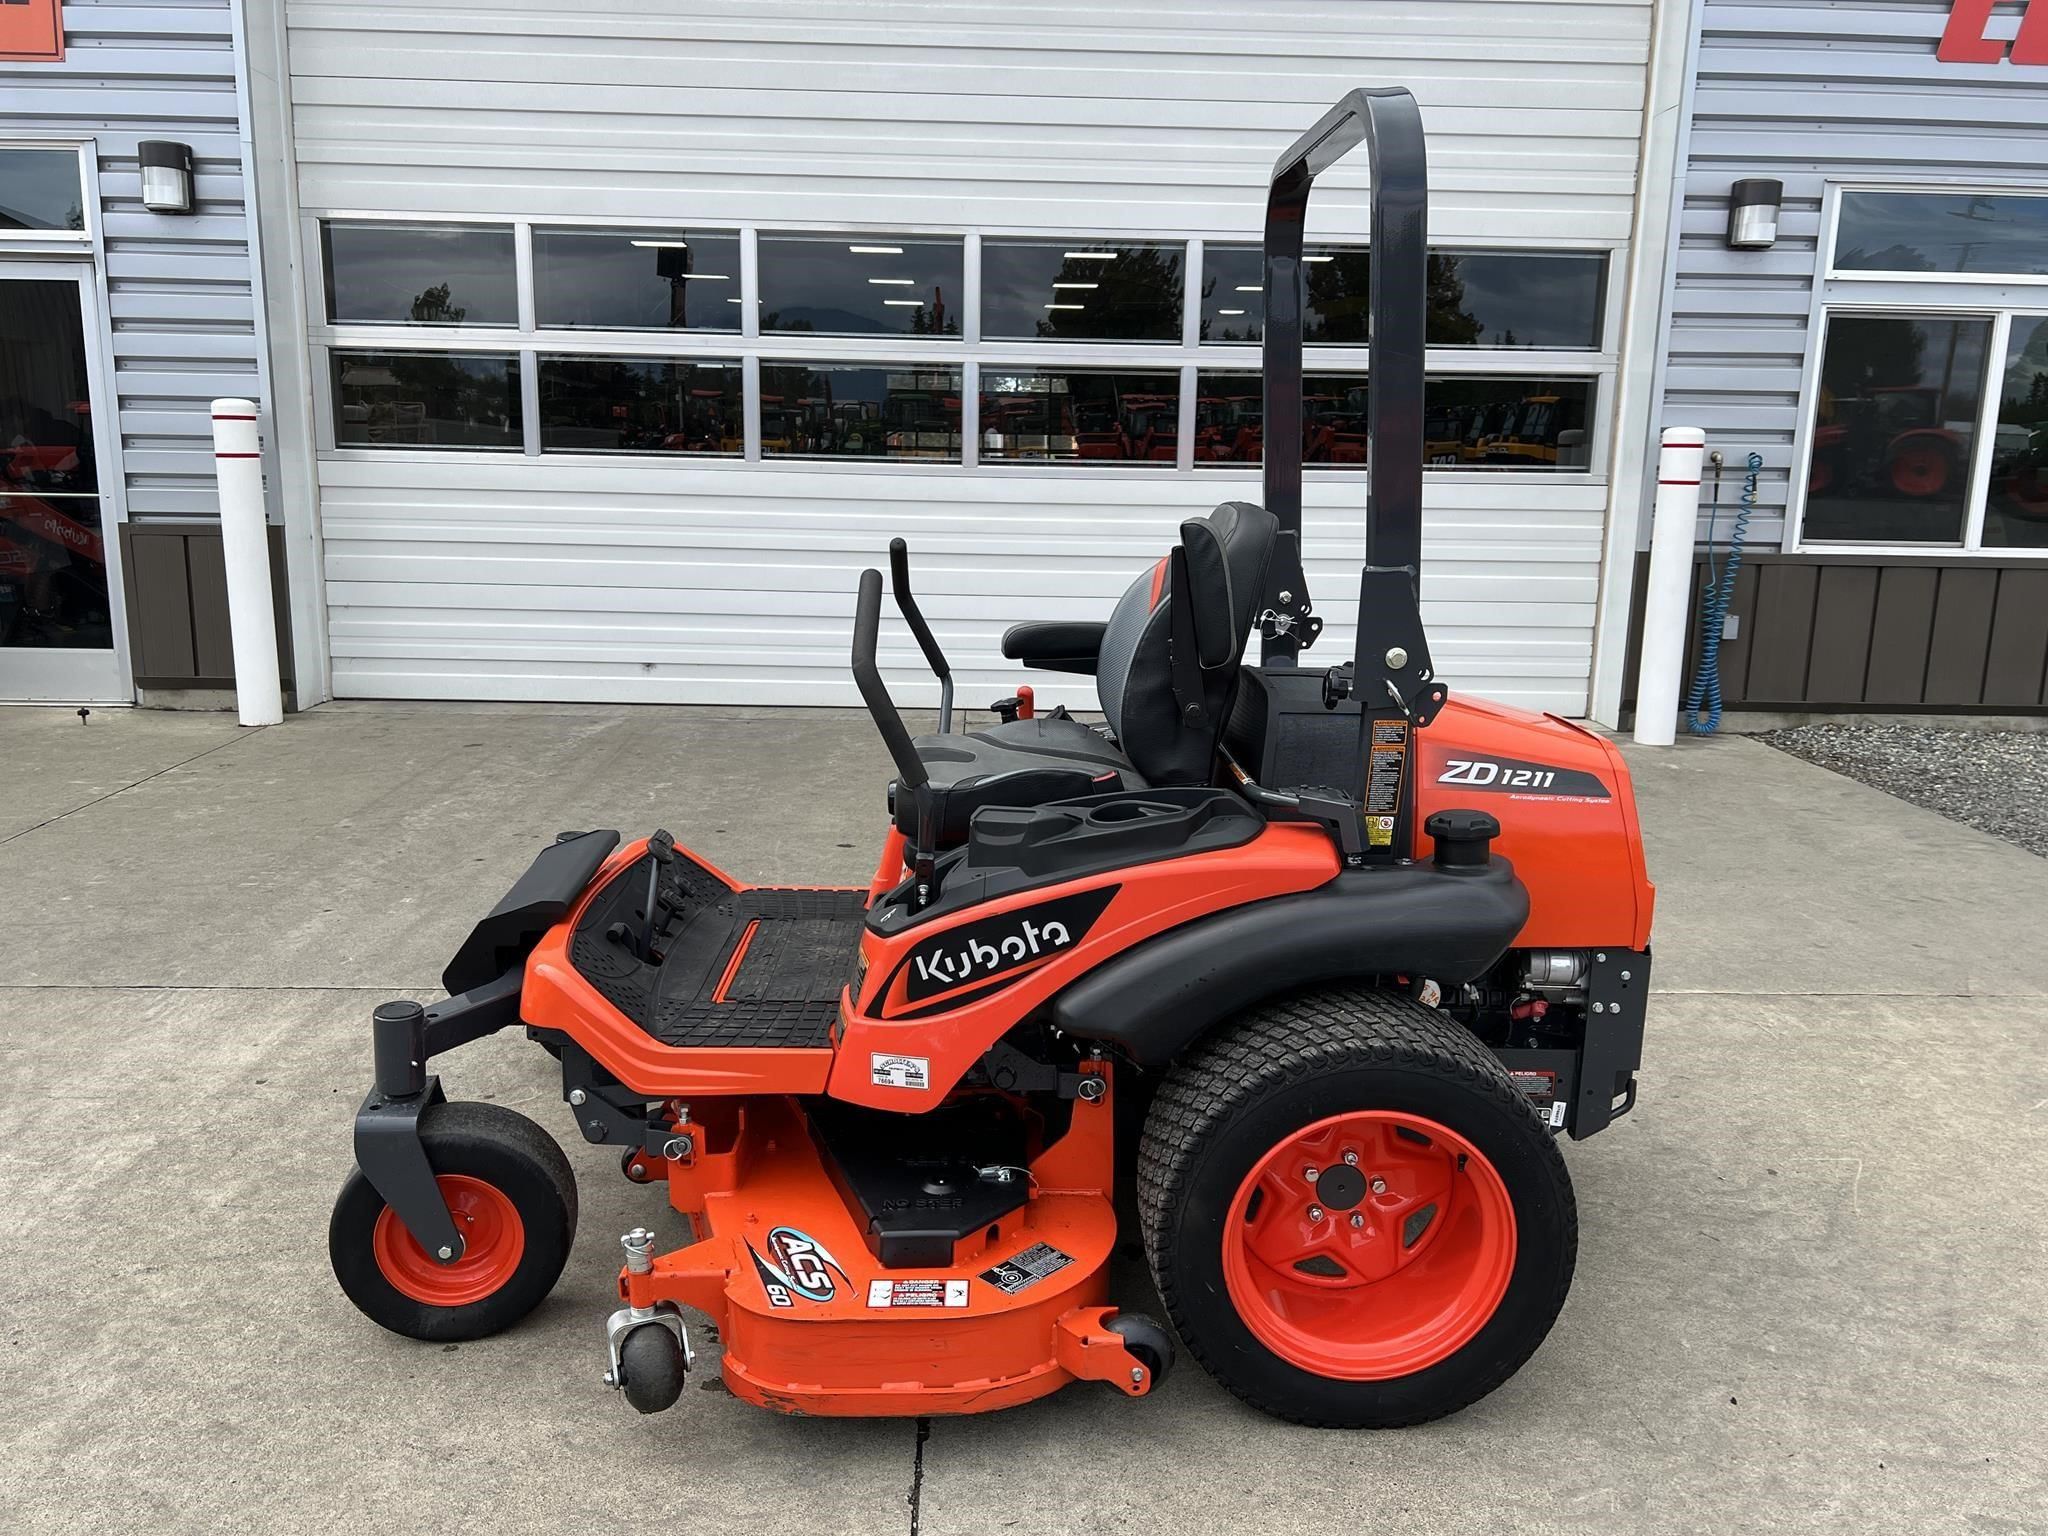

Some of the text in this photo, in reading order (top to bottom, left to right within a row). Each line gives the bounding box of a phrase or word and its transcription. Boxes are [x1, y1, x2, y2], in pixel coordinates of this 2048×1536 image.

[1437, 760, 1556, 788] ZD 1211
[915, 919, 1072, 984] Kubota
[780, 1236, 833, 1289] ACS
[766, 1284, 792, 1305] 60
